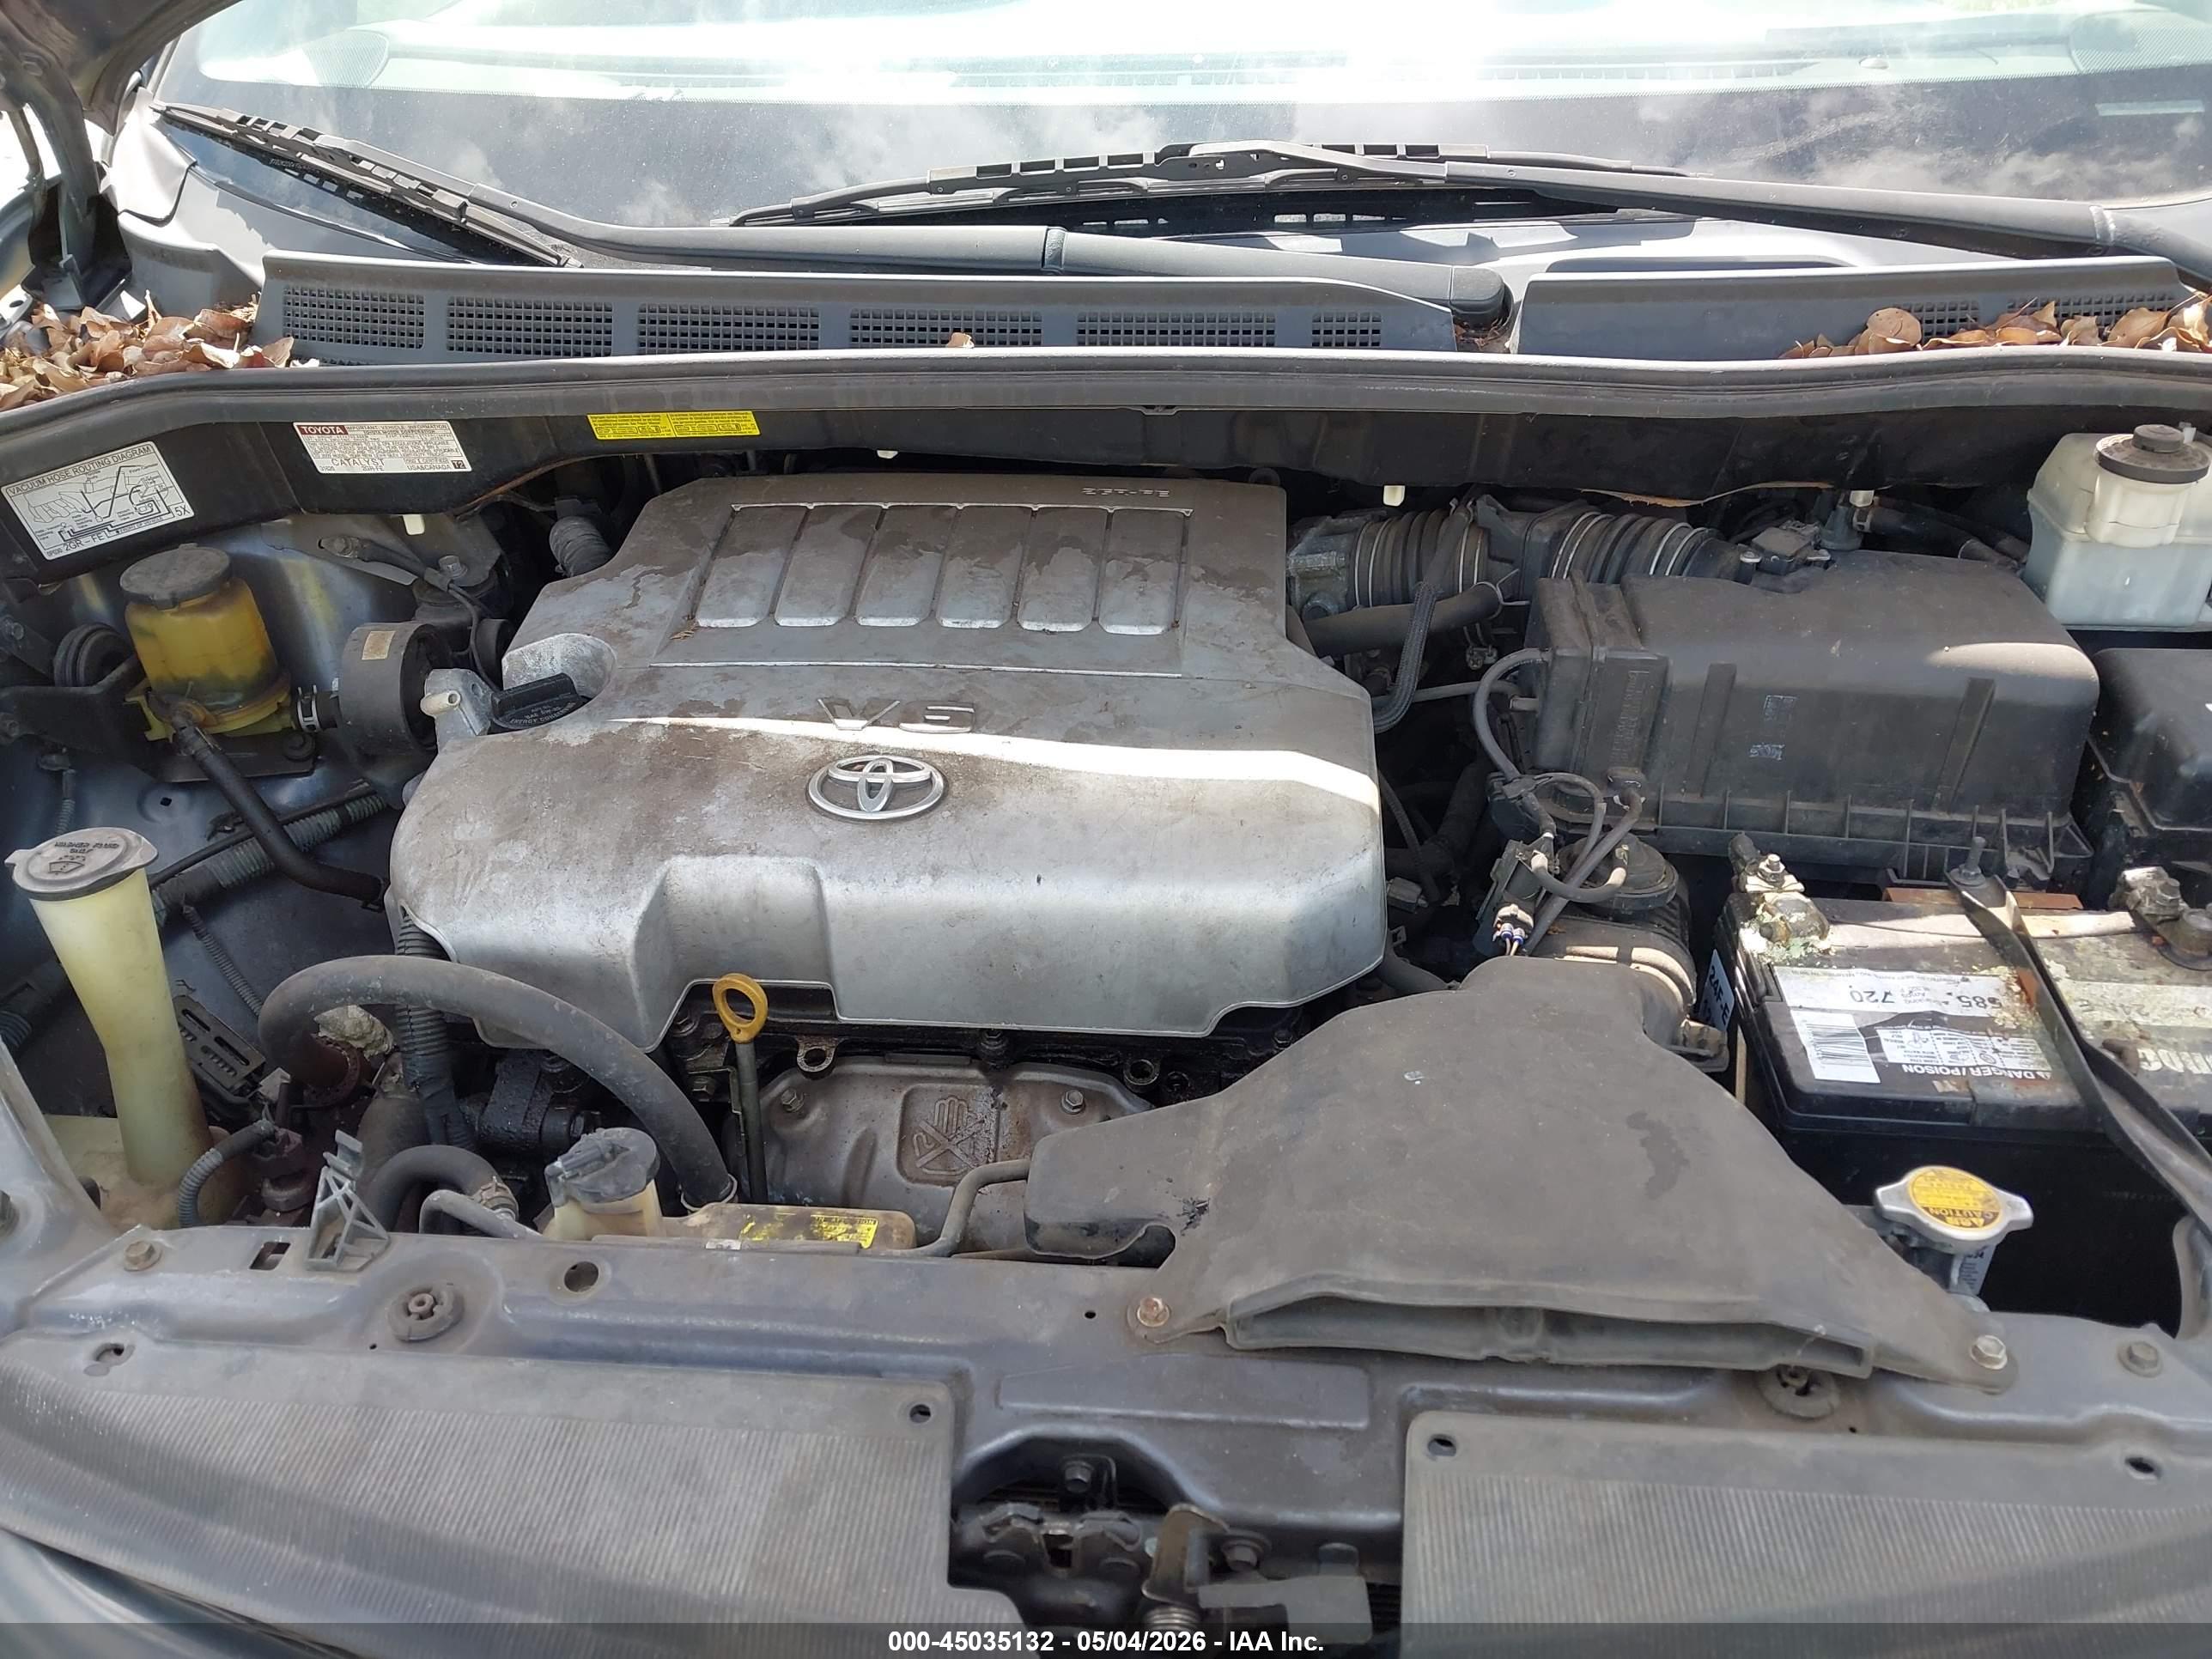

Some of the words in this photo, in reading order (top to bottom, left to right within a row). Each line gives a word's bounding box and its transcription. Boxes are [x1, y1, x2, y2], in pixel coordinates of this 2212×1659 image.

[301, 426, 344, 434] TOYOTA
[331, 459, 386, 467] CATALYST
[453, 460, 465, 469] T2
[8, 478, 46, 495] VACUUM
[48, 471, 72, 485] HOSE
[73, 458, 112, 476] ROUTING
[112, 446, 152, 463] DIAGRAM
[174, 504, 191, 517] 5X
[817, 697, 975, 733] V6
[1850, 990, 1895, 1004] 720
[1956, 995, 2002, 1009] 585
[1929, 1206, 1994, 1219] CAUTION
